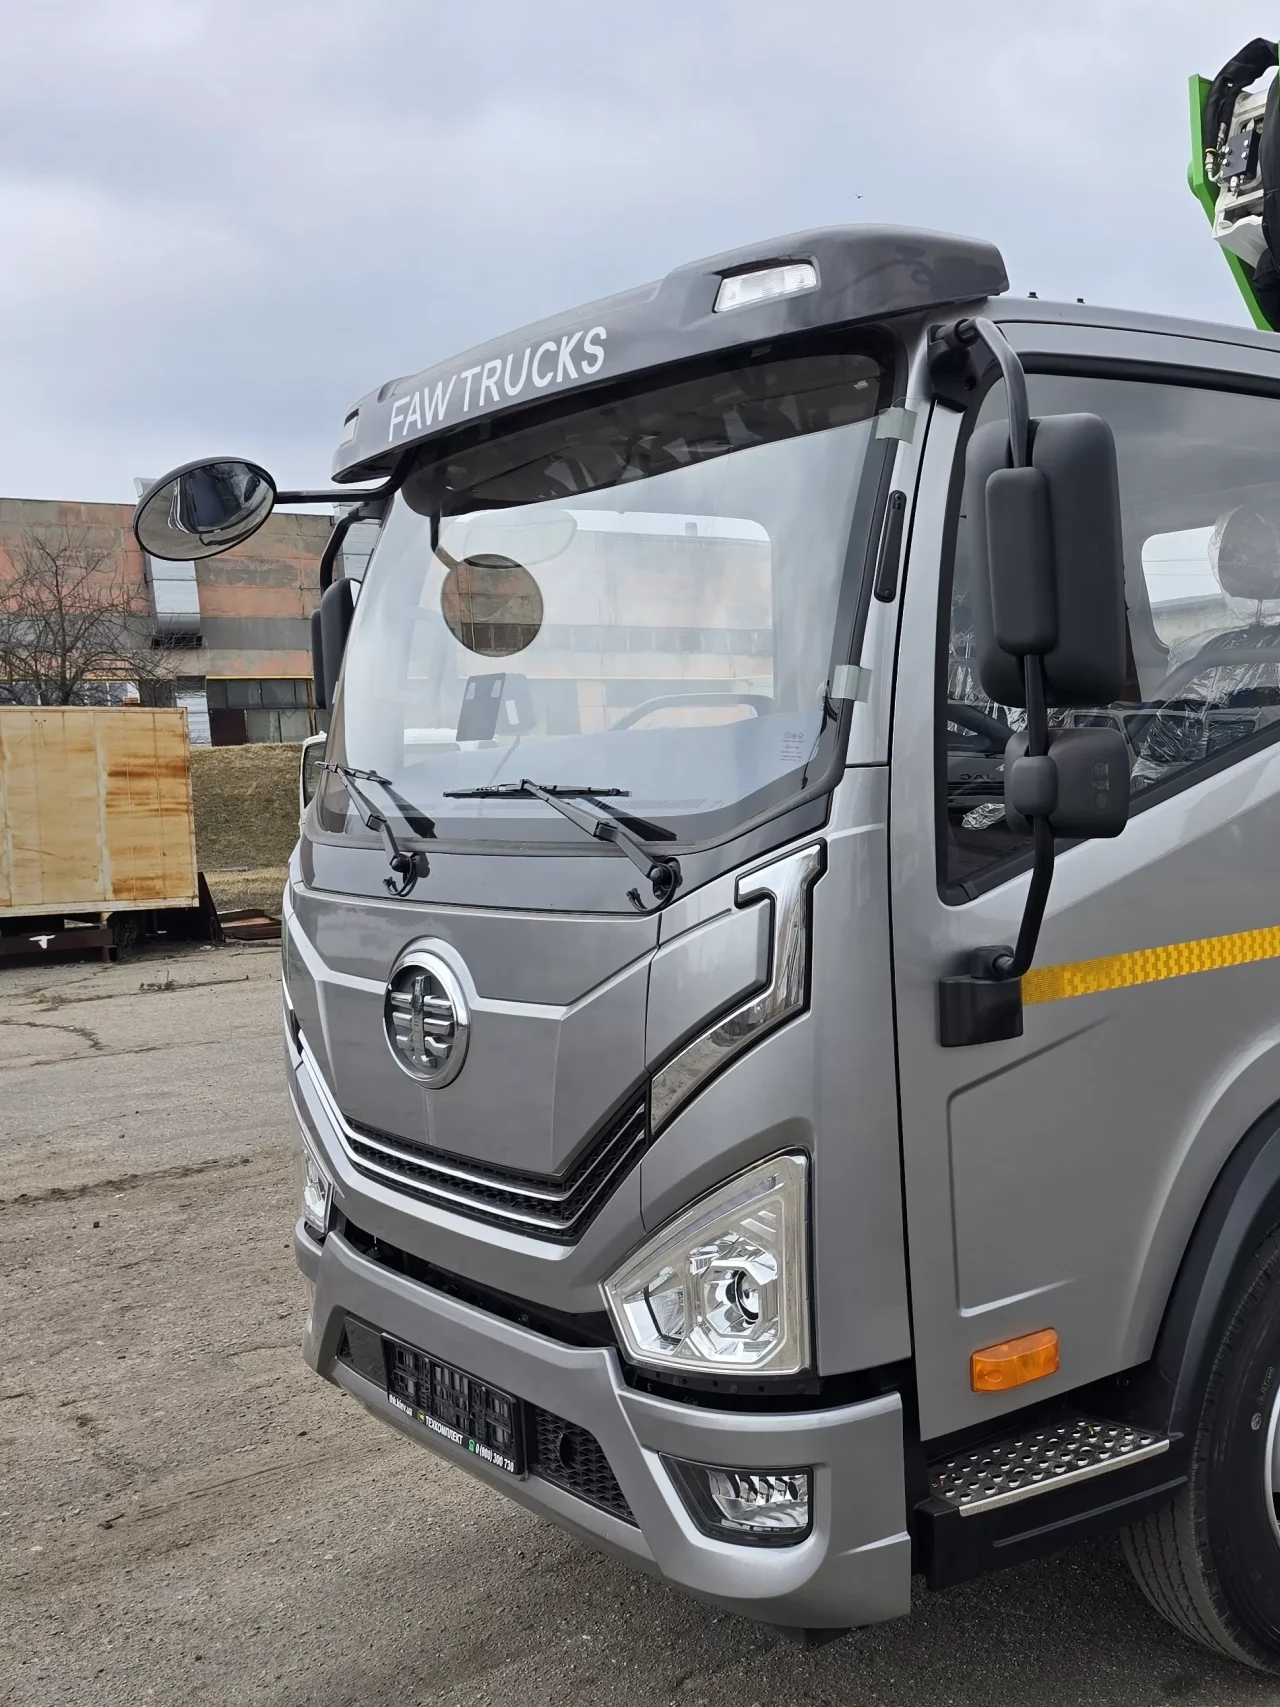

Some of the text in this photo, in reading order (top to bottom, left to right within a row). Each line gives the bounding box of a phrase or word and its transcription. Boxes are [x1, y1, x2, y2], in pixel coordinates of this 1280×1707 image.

[388, 326, 607, 442] FAW TRUCKS
[425, 1415, 464, 1445] ТЕХКОМПЛЕКТ
